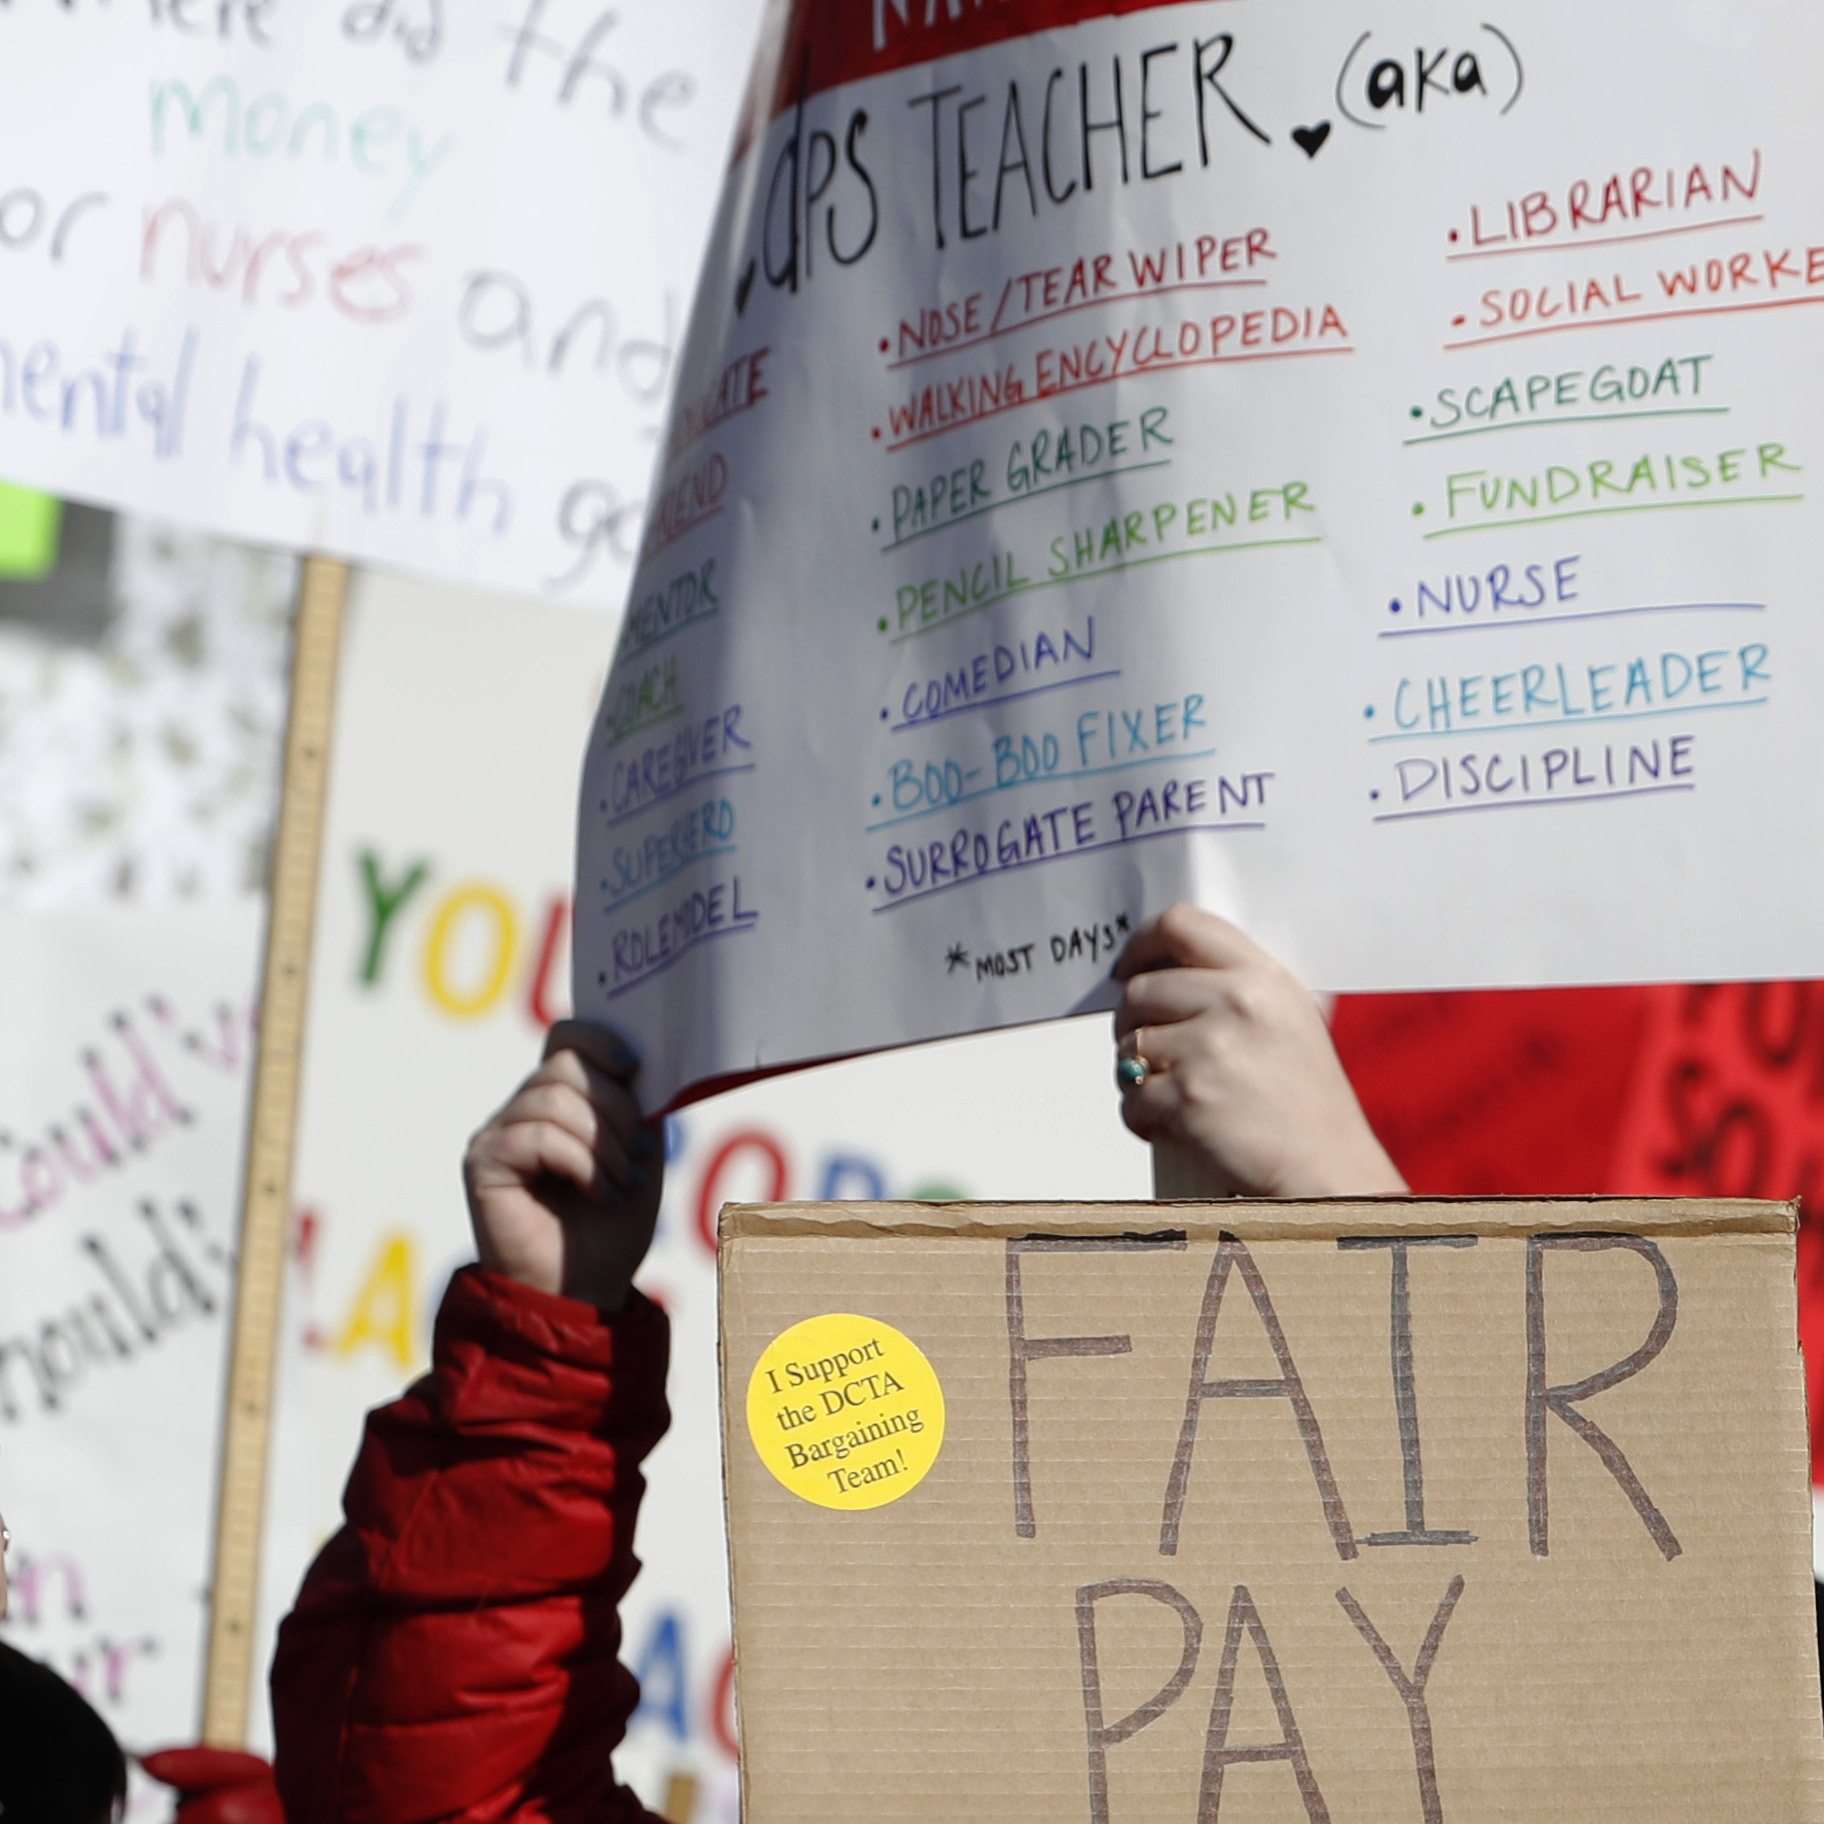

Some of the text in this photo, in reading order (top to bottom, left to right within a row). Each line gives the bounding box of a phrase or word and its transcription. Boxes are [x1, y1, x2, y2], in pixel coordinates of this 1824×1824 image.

[147, 71, 463, 223] money
[908, 33, 1272, 250] TEACHER
[1471, 148, 1763, 247] LIBRARIAN
[139, 194, 429, 327] nurses
[1127, 227, 1278, 290] WIPER
[1480, 274, 1643, 329] SOCIAL
[887, 303, 1348, 440] WALKING ENCYCLOPEDIA
[1428, 354, 1715, 430] SCAPEGOAT
[230, 351, 517, 538] health
[890, 405, 1175, 536] PAPER GRADER
[1446, 441, 1803, 518] FUNDRAISER
[895, 480, 1315, 628] PENCIL SHARPENER
[1416, 554, 1582, 617] NURSE
[902, 615, 1096, 721] COMEDIAN
[1393, 641, 1773, 732] CHEERLEADER
[888, 693, 1206, 815] BOO-BOO FIXER
[1395, 734, 1696, 802] DISCIPLINE
[883, 772, 1276, 896] SURROGATE PARENT
[765, 1338, 886, 1394] I Support
[776, 1370, 906, 1431] the DCTA
[1004, 1229, 1684, 1562] FAIR
[783, 1408, 926, 1470] Bargaining
[826, 1448, 909, 1494] Team!
